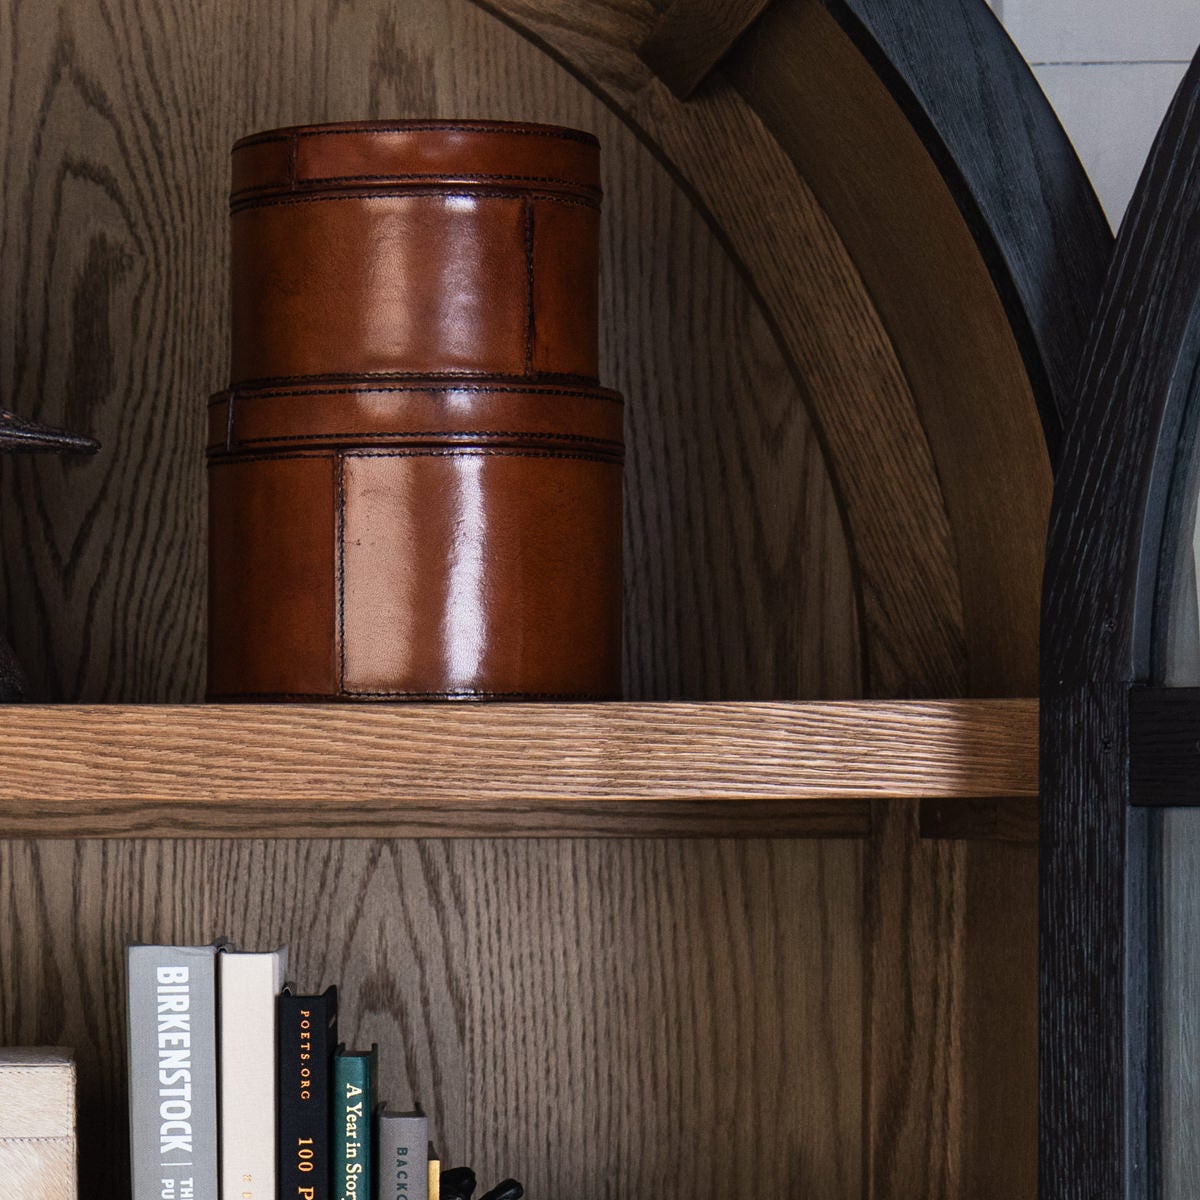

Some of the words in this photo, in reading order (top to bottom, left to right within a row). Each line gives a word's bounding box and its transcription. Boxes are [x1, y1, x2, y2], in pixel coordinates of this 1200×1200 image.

[157, 966, 193, 1154] BIRKENSTOCK
[300, 1009, 311, 1101] POETS.ORG
[346, 1083, 362, 1098] A
[346, 1101, 363, 1139] Year
[297, 1137, 314, 1172] 100
[346, 1142, 361, 1159] in
